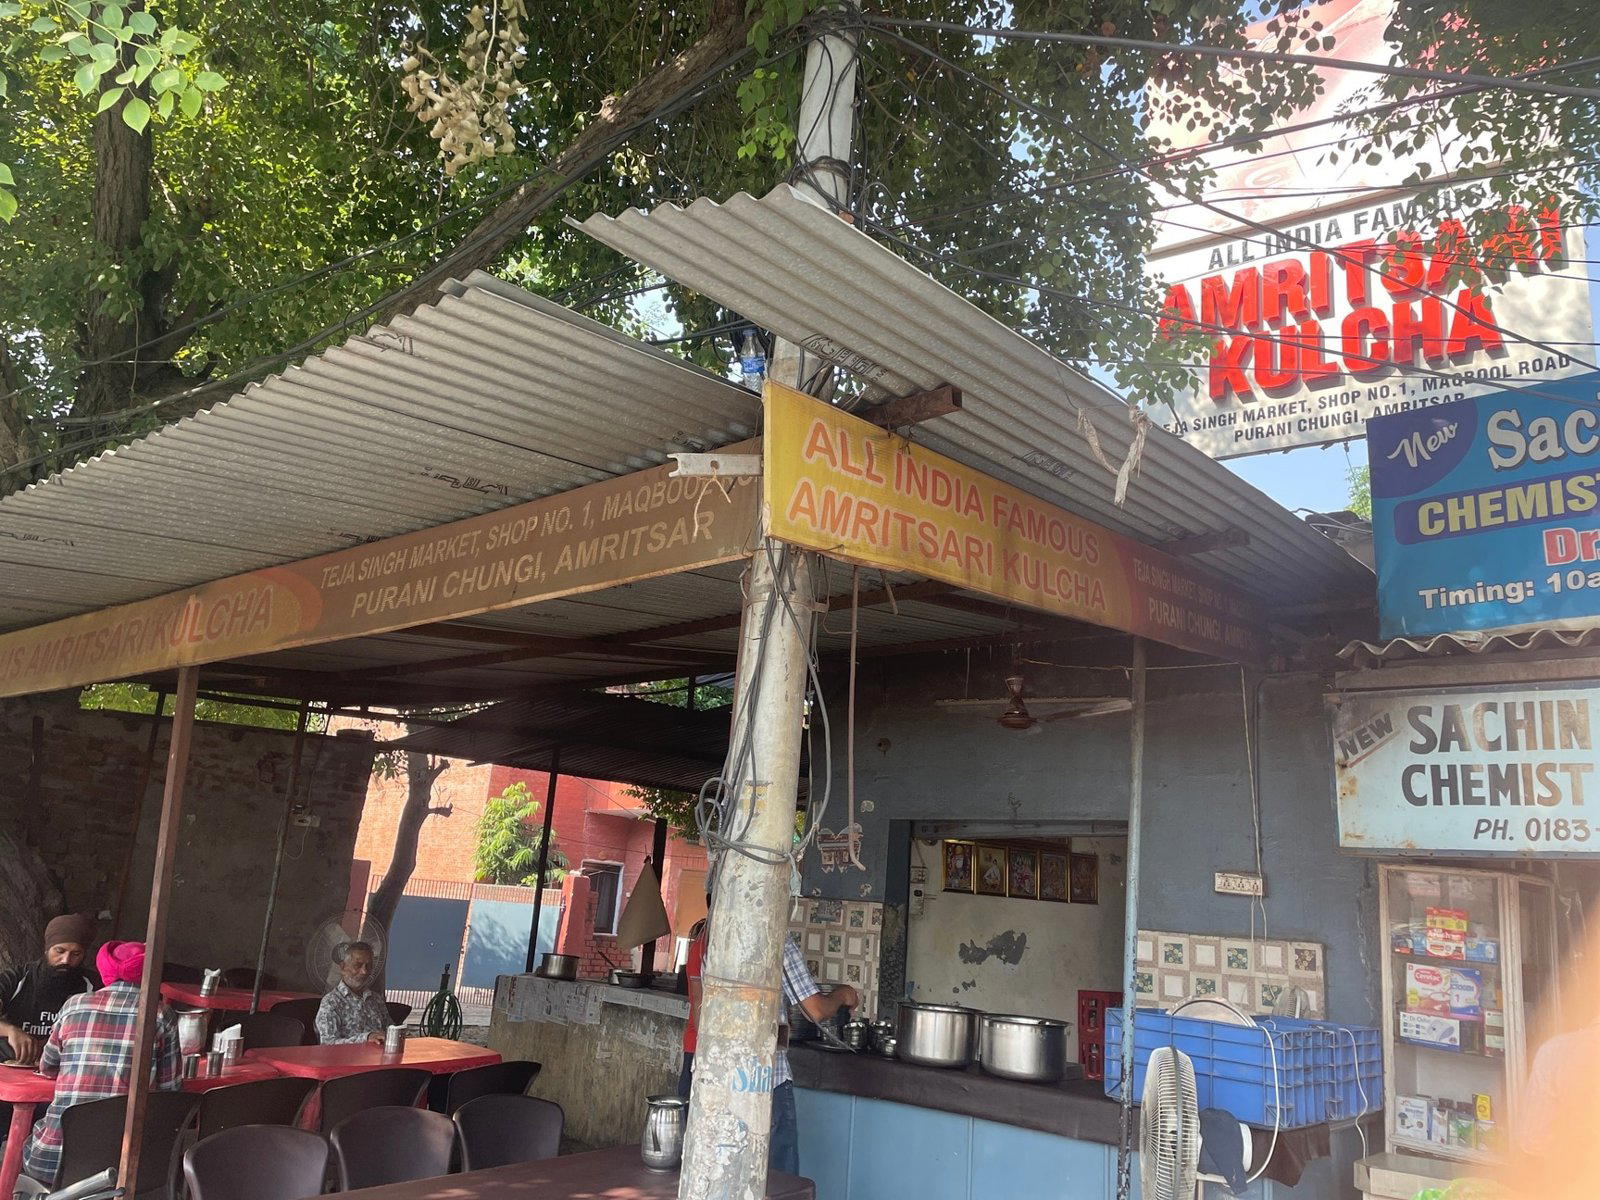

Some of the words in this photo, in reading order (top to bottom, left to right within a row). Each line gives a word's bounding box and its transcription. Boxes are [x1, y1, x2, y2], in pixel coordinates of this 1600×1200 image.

[1208, 241, 1255, 270] ALL
[1266, 219, 1342, 257] INDIA
[1208, 286, 1503, 400] KULCHA
[1193, 412, 1237, 431] SINGH
[1243, 400, 1311, 422] MARKET,
[1319, 390, 1360, 409] SHOP
[1423, 364, 1513, 392] MAQBOOL
[1519, 354, 1571, 375] ROAD
[1235, 422, 1291, 442] PURANI
[1298, 410, 1365, 432] CHUNGI,
[1387, 421, 1458, 468] New
[1487, 406, 1600, 470] Sac
[804, 420, 885, 485] ALL
[894, 450, 985, 522] INDIA
[993, 493, 1100, 565] FAMOUS
[1417, 473, 1600, 536] CHEMIS
[321, 561, 355, 589] TEJA
[358, 548, 408, 581] SINGH
[409, 530, 481, 569] MARKET,
[486, 516, 539, 550] SHOP
[541, 506, 573, 537] NO.
[350, 576, 438, 618] PURANI
[443, 552, 546, 598] CHUNGI,
[554, 511, 715, 575] AMRITSAR
[787, 480, 993, 577] AMRITSARI
[1002, 549, 1107, 611] KULCHA
[151, 584, 274, 652] KULCHA
[1148, 597, 1186, 631] PURANI
[1418, 580, 1535, 609] Timing:
[1338, 712, 1394, 759] NEW
[1407, 699, 1592, 755] SACHIN
[1402, 762, 1595, 807] CHEMIST
[1473, 818, 1514, 841] PH.
[40, 1011, 59, 1023] Fly
